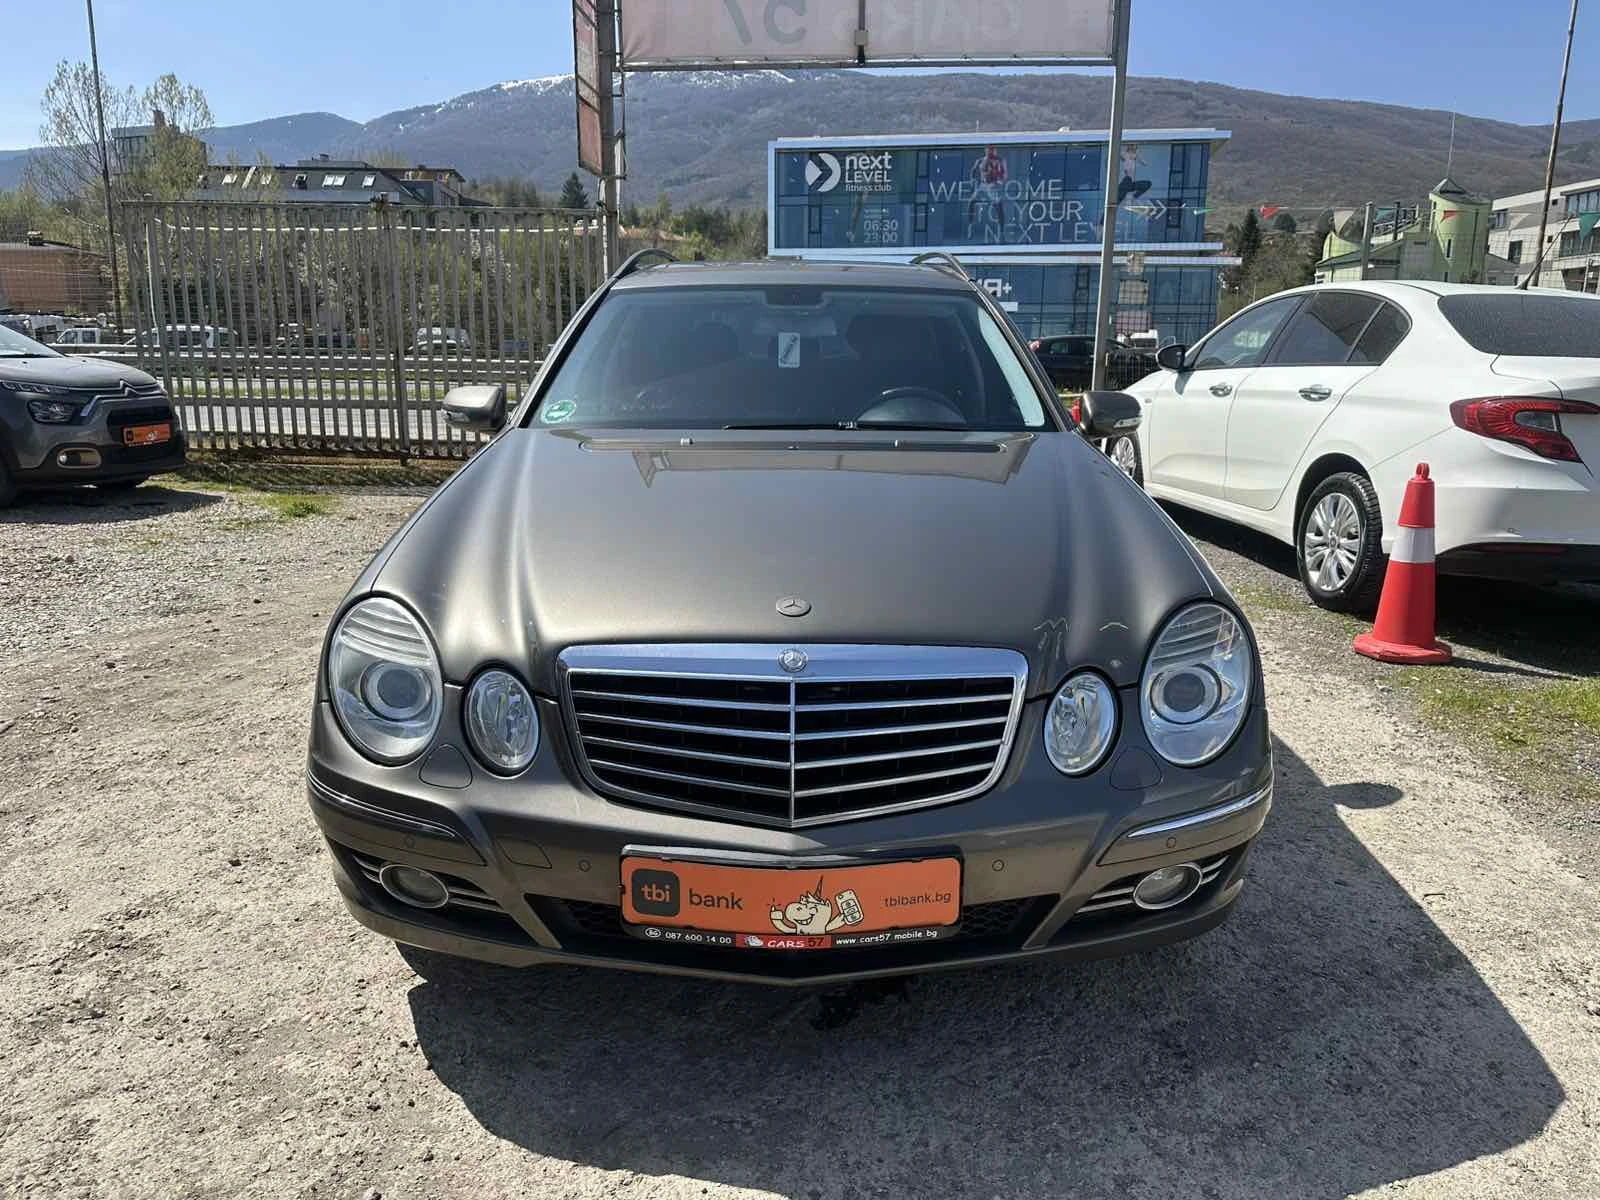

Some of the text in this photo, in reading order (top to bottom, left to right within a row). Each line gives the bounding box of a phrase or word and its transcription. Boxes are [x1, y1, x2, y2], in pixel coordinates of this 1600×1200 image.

[845, 151, 892, 170] next
[845, 170, 892, 183] LEVEL
[845, 183, 892, 192] fitness club
[1014, 200, 1084, 223] YOUR
[863, 219, 898, 231] 06:30
[863, 231, 898, 243] 23:00
[984, 222, 1136, 244] NEXT LEVL
[641, 882, 744, 910] tbi bank
[884, 891, 952, 907] tbibank.bg
[719, 936, 732, 944] 00
[767, 937, 825, 948] CARS 57
